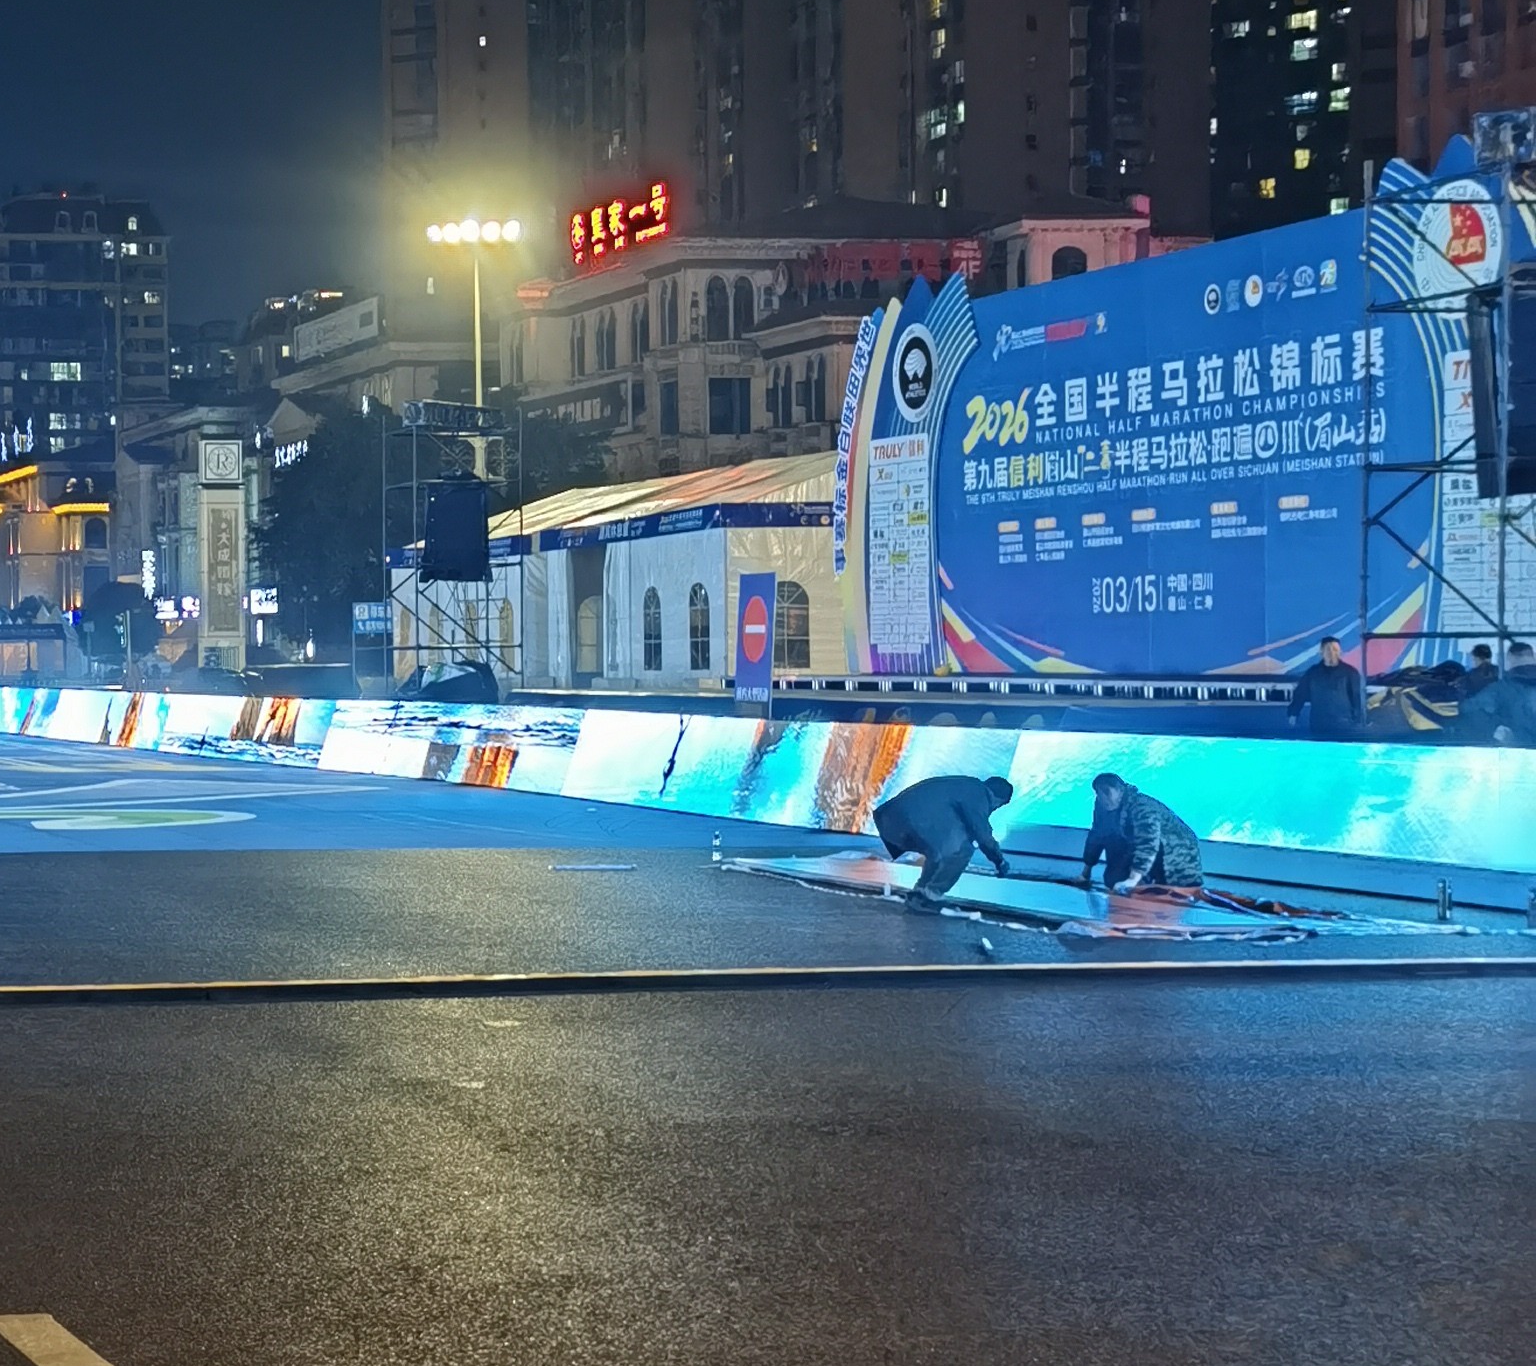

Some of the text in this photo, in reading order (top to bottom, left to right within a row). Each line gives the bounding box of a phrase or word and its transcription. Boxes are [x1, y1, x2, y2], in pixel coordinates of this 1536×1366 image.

[962, 327, 1385, 455] 2026 全国半程马拉松锦标赛
[1035, 381, 1385, 444] NATIONAL HALF MARATHON CHAMPIONSHIS
[873, 441, 905, 461] TRULY
[966, 494, 979, 505] THE
[997, 490, 1022, 502] TRULY
[1057, 482, 1094, 496] RENSHOU
[1096, 478, 1117, 492] HALF
[1191, 469, 1208, 483] ALL
[1210, 466, 1235, 480] OVER
[1238, 462, 1279, 477] SICHUAN
[1092, 574, 1157, 614] 2026 03/15
